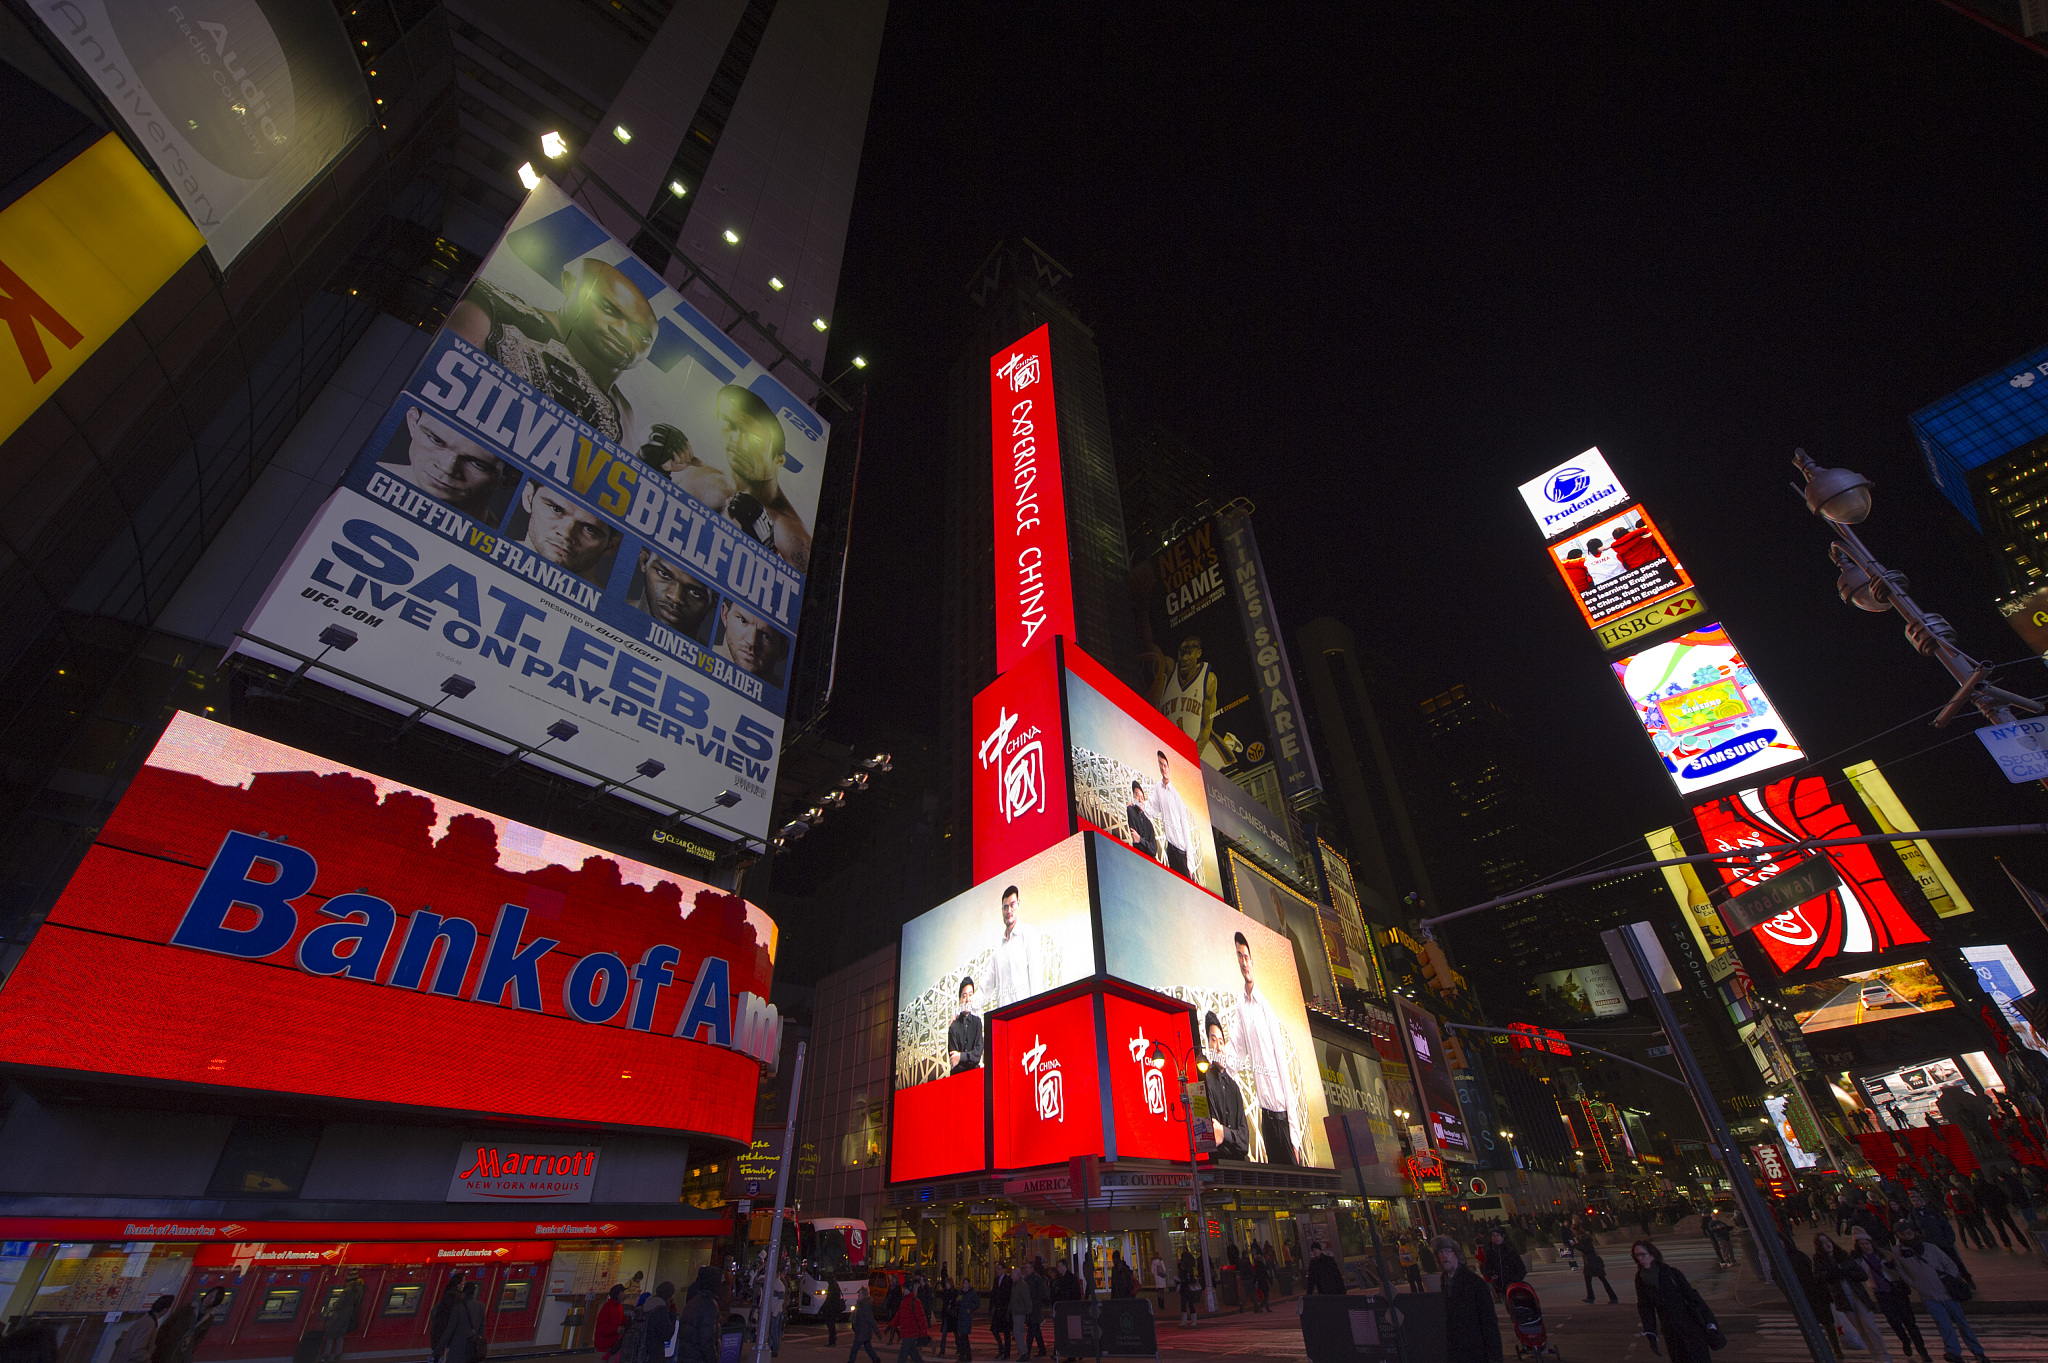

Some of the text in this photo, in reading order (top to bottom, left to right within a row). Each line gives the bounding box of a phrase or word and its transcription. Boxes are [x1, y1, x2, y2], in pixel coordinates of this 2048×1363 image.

[167, 5, 211, 66] Radio
[196, 20, 279, 143] Audio
[49, 1, 220, 229] Anniversary
[1015, 354, 1039, 370] CHINA
[778, 406, 820, 443] 126
[453, 336, 802, 580] WORLD MIDDLEWEIGHT CHAMPIONSHIP
[1011, 399, 1042, 537] EXPERIENCE
[420, 348, 802, 625] SILVA VS BELFORT
[1542, 483, 1617, 527] Prudential
[365, 471, 603, 614] GRIFFIN VS FRANKLIN
[1158, 521, 1212, 579] NEW
[1590, 555, 1611, 567] CHINA
[1163, 546, 1219, 594] YORK'S
[1580, 557, 1667, 599] Five times more people
[1585, 569, 1659, 606] are learning English
[300, 586, 385, 628] UFC.COM
[1018, 546, 1048, 648] CHINA
[1165, 563, 1224, 617] GAME
[1592, 610, 1606, 620] are
[1605, 598, 1632, 614] people
[1640, 580, 1677, 599] England.
[1596, 596, 1622, 609] China,
[1621, 586, 1640, 598] than
[1639, 577, 1661, 590] there
[1600, 610, 1663, 646] HSBC
[2000, 601, 2027, 620] LANE
[331, 518, 548, 654] SAT.
[557, 625, 727, 743] FEB.
[731, 714, 775, 762] 5
[539, 597, 663, 663] PRESENTED BY BUD LIGHT
[1226, 528, 1300, 759] TIMES SQUARE
[310, 557, 438, 632] LIVE
[442, 619, 521, 669] ON
[520, 653, 770, 785] PAY-PER-VIEW
[645, 621, 764, 702] JONES VS BADER
[1681, 698, 1722, 716] SAMSUNG
[1005, 725, 1042, 755] CHINA
[1991, 721, 2045, 742] NYPD
[1690, 737, 1770, 771] SAMSUNG
[1288, 770, 1306, 784] NYC
[1738, 869, 1816, 919] Broadway
[170, 829, 559, 1014] Bank
[562, 943, 682, 1032] of
[1590, 968, 1600, 977] By
[1673, 931, 1713, 999] NOVOTEL
[1594, 987, 1606, 996] did
[1021, 1034, 1064, 1123] 中國
[1039, 1058, 1062, 1072] CHINA
[1128, 1026, 1168, 1122] 中國
[1318, 1063, 1337, 1083] ho's
[1322, 1079, 1352, 1110] PIERS
[459, 1146, 596, 1180] Marriott
[750, 1140, 771, 1150] The
[1759, 1147, 1783, 1180] tkts
[466, 1180, 580, 1192] NEW YORK MARQUIS
[739, 1163, 777, 1179] Family
[1023, 1177, 1071, 1193] AMERICA
[124, 1224, 216, 1236] Bank of America
[535, 1224, 598, 1234] Bank of America
[254, 1250, 320, 1260] Bank of America
[437, 1248, 493, 1258] Bank of America
